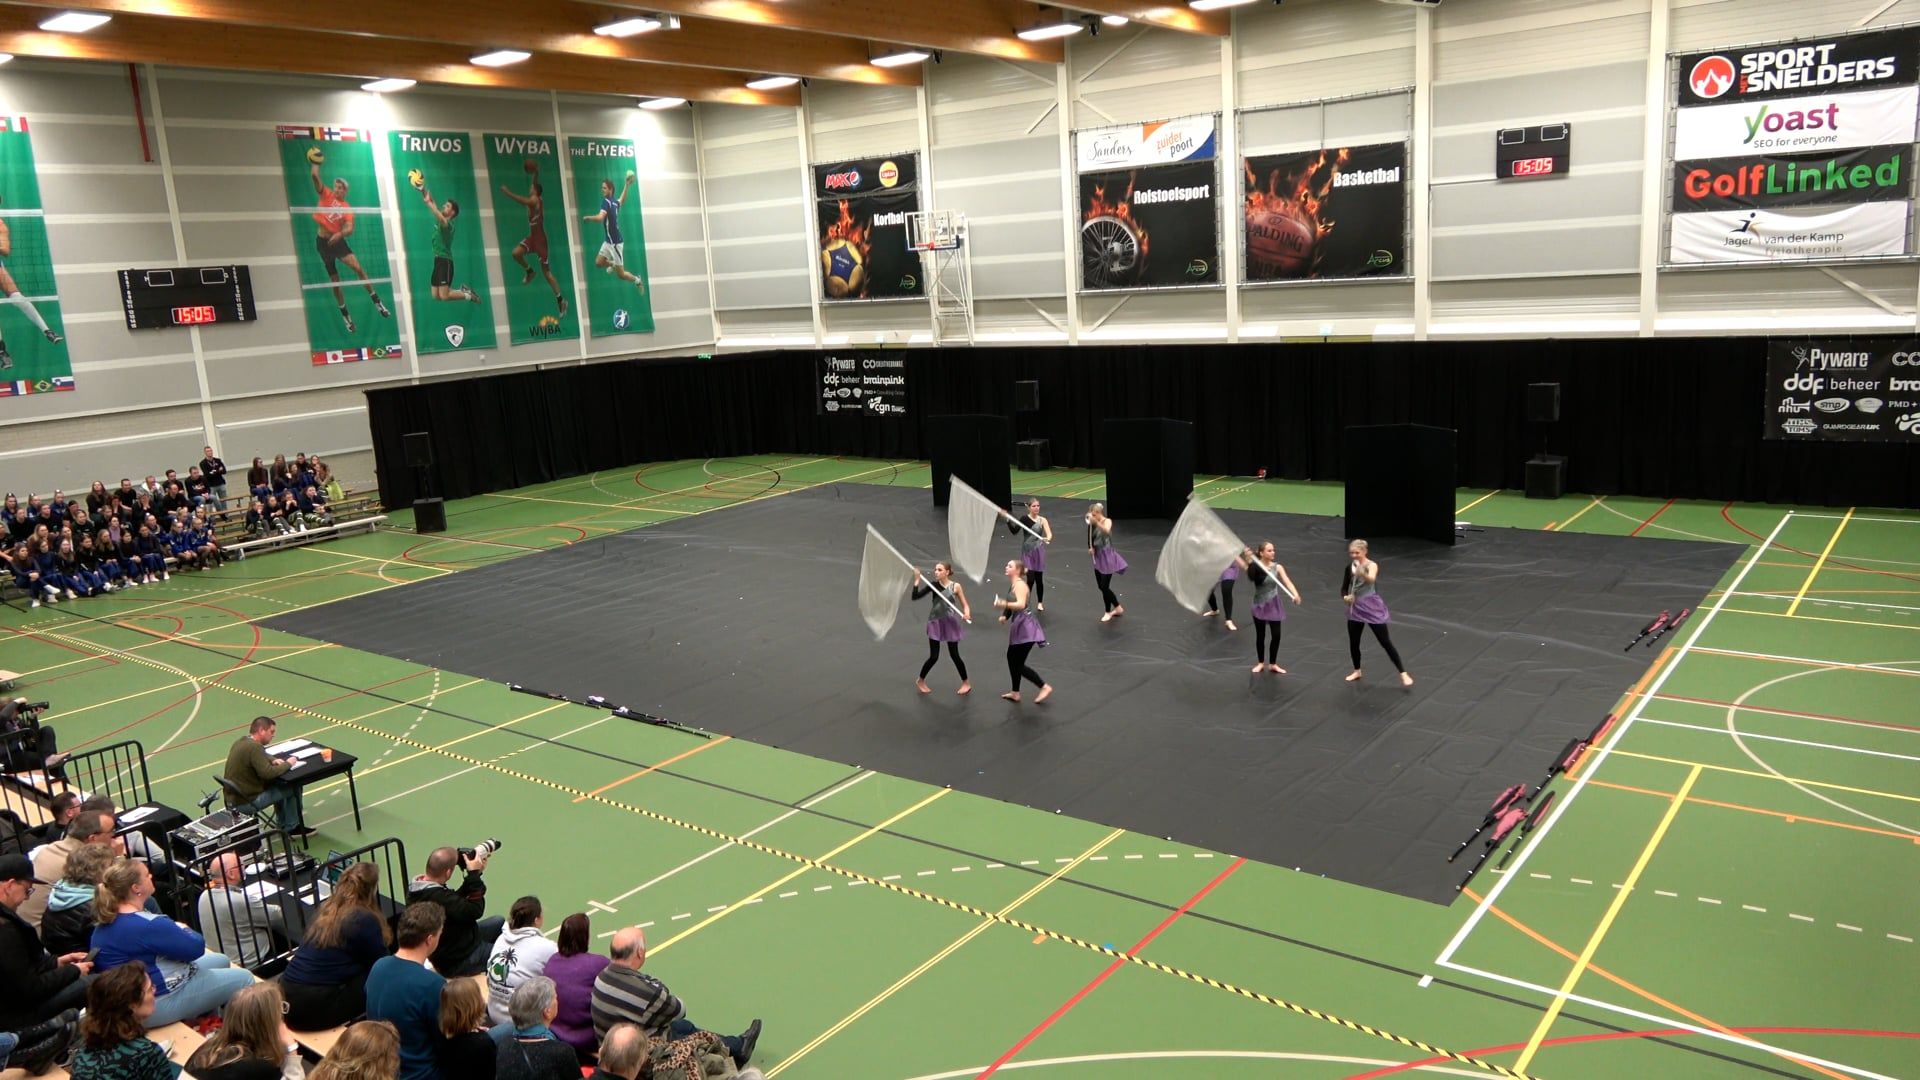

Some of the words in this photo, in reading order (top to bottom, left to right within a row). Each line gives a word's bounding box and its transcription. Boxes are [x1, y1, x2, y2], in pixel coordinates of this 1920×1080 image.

[1740, 43, 1836, 74] SPORT
[1746, 56, 1896, 93] SNELDERS
[398, 134, 462, 153] TRIVOS
[494, 136, 550, 154] WYBA
[587, 142, 635, 157] FLYERS
[1088, 139, 1134, 160] Sanders
[1156, 131, 1183, 150] zuider
[1169, 136, 1194, 158] poort
[1753, 139, 1774, 148] SEO
[1776, 137, 1790, 147] for
[1793, 134, 1838, 146] everyone
[1518, 159, 1552, 174] 15:05
[1333, 166, 1400, 188] Basketbal
[1684, 154, 1900, 199] GolfLinked
[1133, 184, 1210, 204] Rolstoelsport
[873, 211, 905, 226] Korfbal
[1723, 236, 1753, 247] Jager
[1764, 236, 1784, 244] van
[1787, 232, 1807, 243] der
[1809, 232, 1844, 244] Kamp
[178, 307, 211, 322] 15:05
[831, 356, 856, 371] Pyware
[1810, 348, 1869, 371] Pyware
[823, 372, 839, 387] ddf
[863, 374, 905, 387] brainpink
[1783, 373, 1824, 395] ddf
[1830, 377, 1880, 390] beheer
